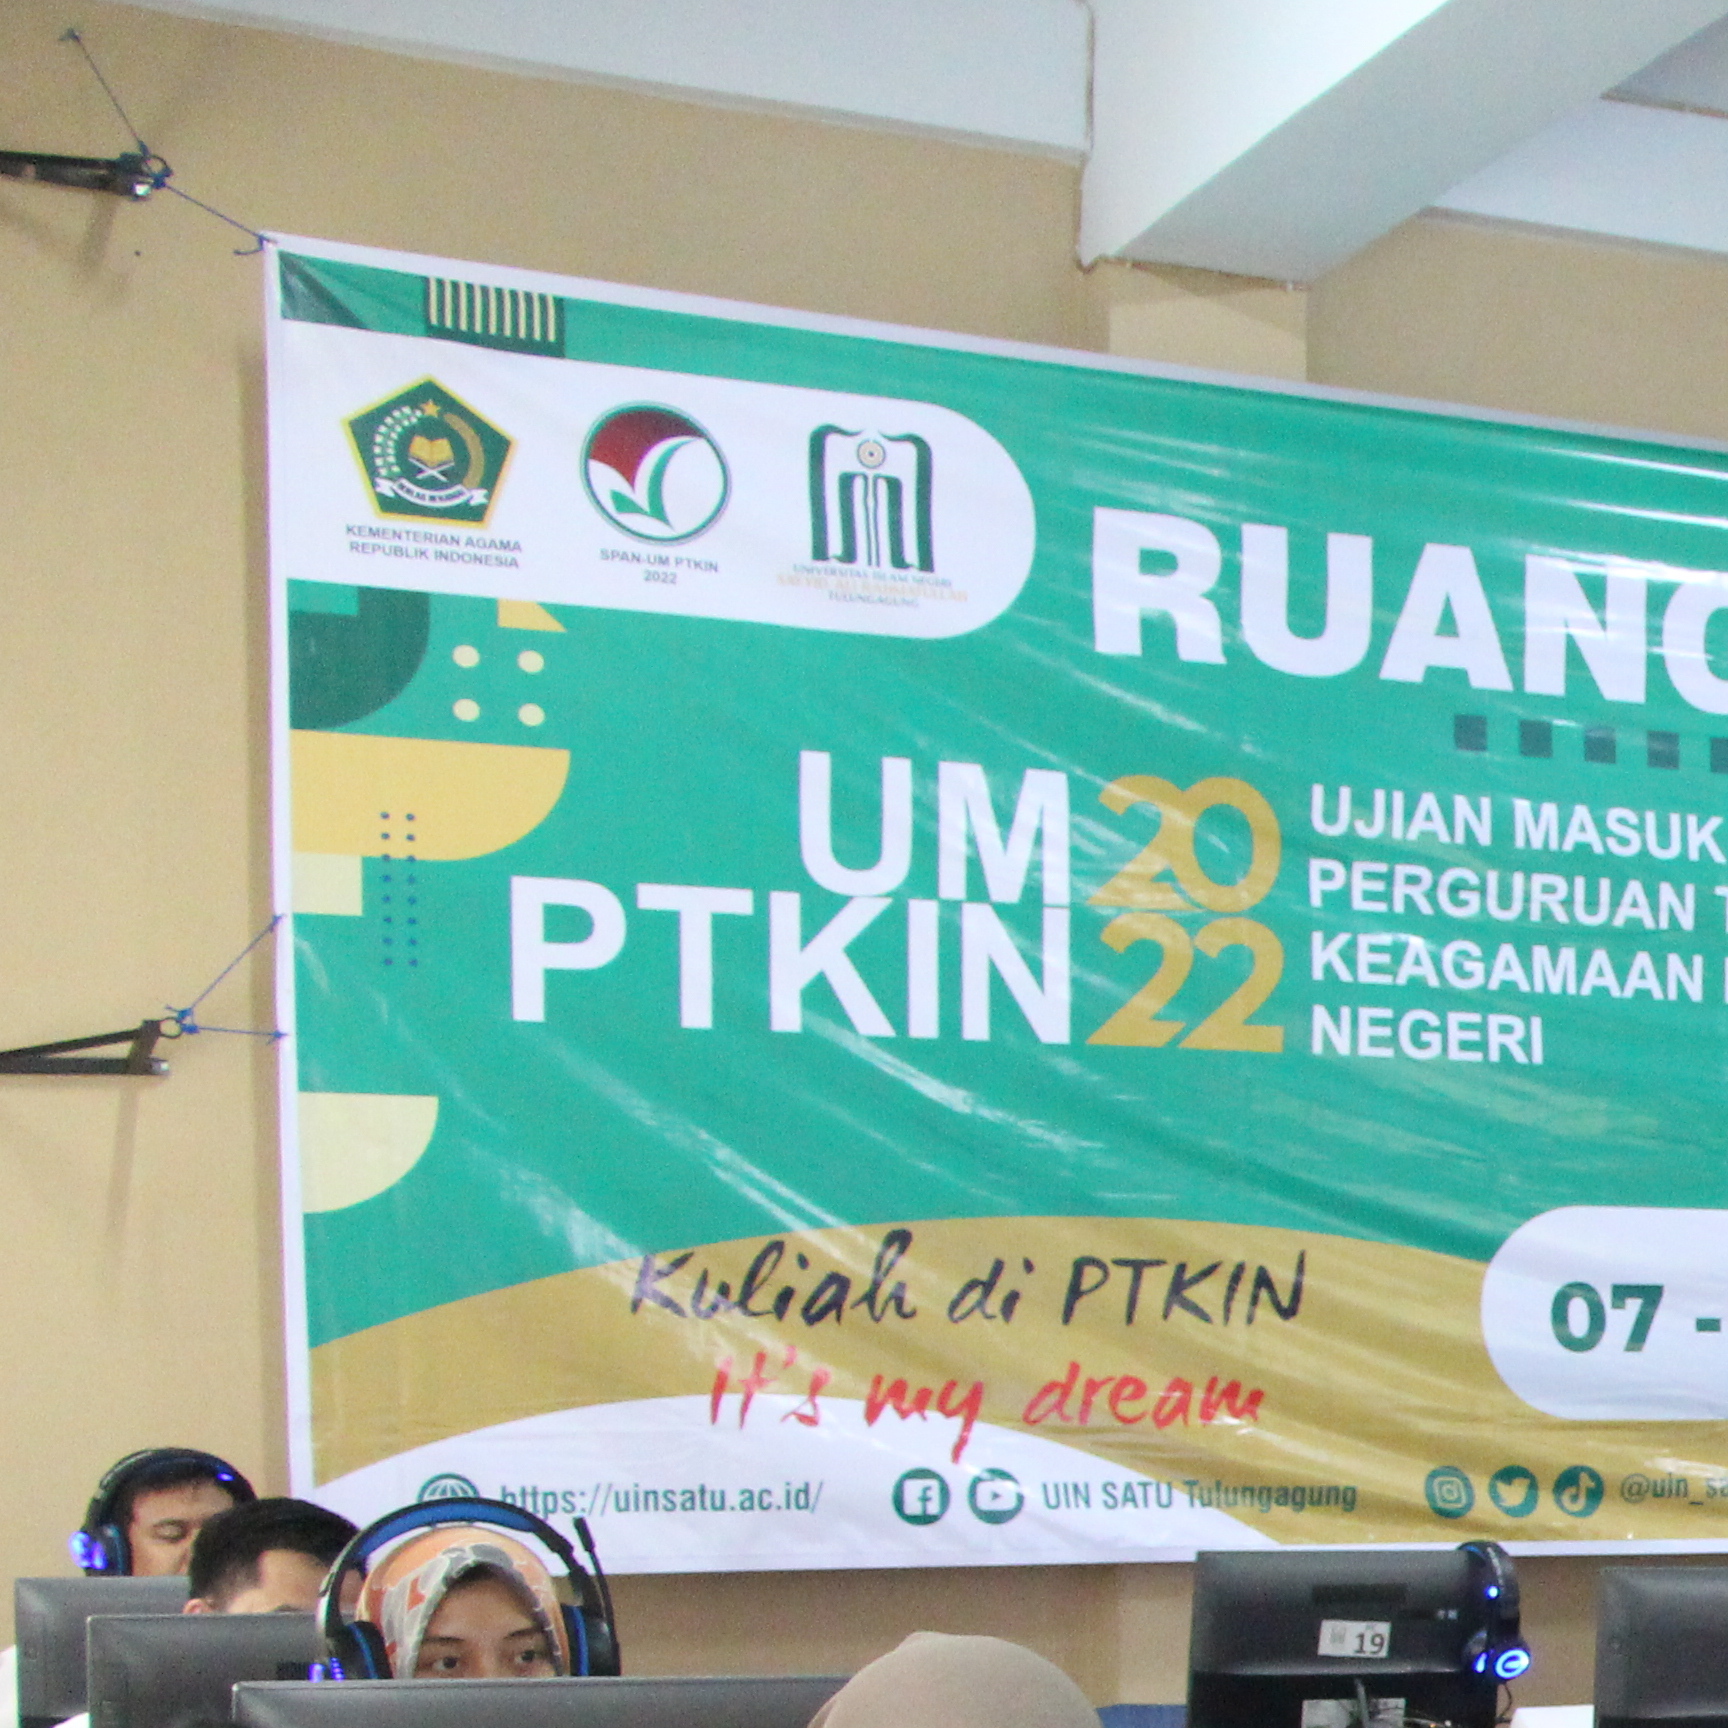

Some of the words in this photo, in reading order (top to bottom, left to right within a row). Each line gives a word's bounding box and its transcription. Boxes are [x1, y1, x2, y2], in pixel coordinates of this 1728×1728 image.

[345, 524, 460, 549] KEMENTERIAN
[464, 537, 522, 552] AGAMA
[349, 541, 429, 560] REPUBLIK
[433, 550, 520, 569] INDONESIA
[600, 548, 671, 567] SPAN-UM
[674, 557, 719, 573] PTKIN
[644, 569, 678, 585] 2022
[799, 750, 1070, 905] UM
[1309, 783, 1494, 848] UJIAN
[1515, 800, 1727, 864] MASUK
[1308, 858, 1696, 933] PERGURUAN
[510, 876, 1071, 1044] PTKIN
[1310, 931, 1704, 1003] KEAGAMAAN
[1310, 1004, 1544, 1065] NEGERI
[629, 1228, 919, 1327] Kuliah
[947, 1256, 1036, 1325] di
[1061, 1250, 1307, 1327] PTKIN
[1550, 1281, 1664, 1354] 07
[863, 1372, 986, 1465] my
[1021, 1361, 1266, 1431] dream
[500, 1481, 824, 1520] https://uinsatu.ac.id/
[1042, 1481, 1090, 1510] UIN
[1102, 1481, 1173, 1510] SATU
[1183, 1480, 1357, 1514] Tulungagung
[1354, 1633, 1385, 1655] 19
